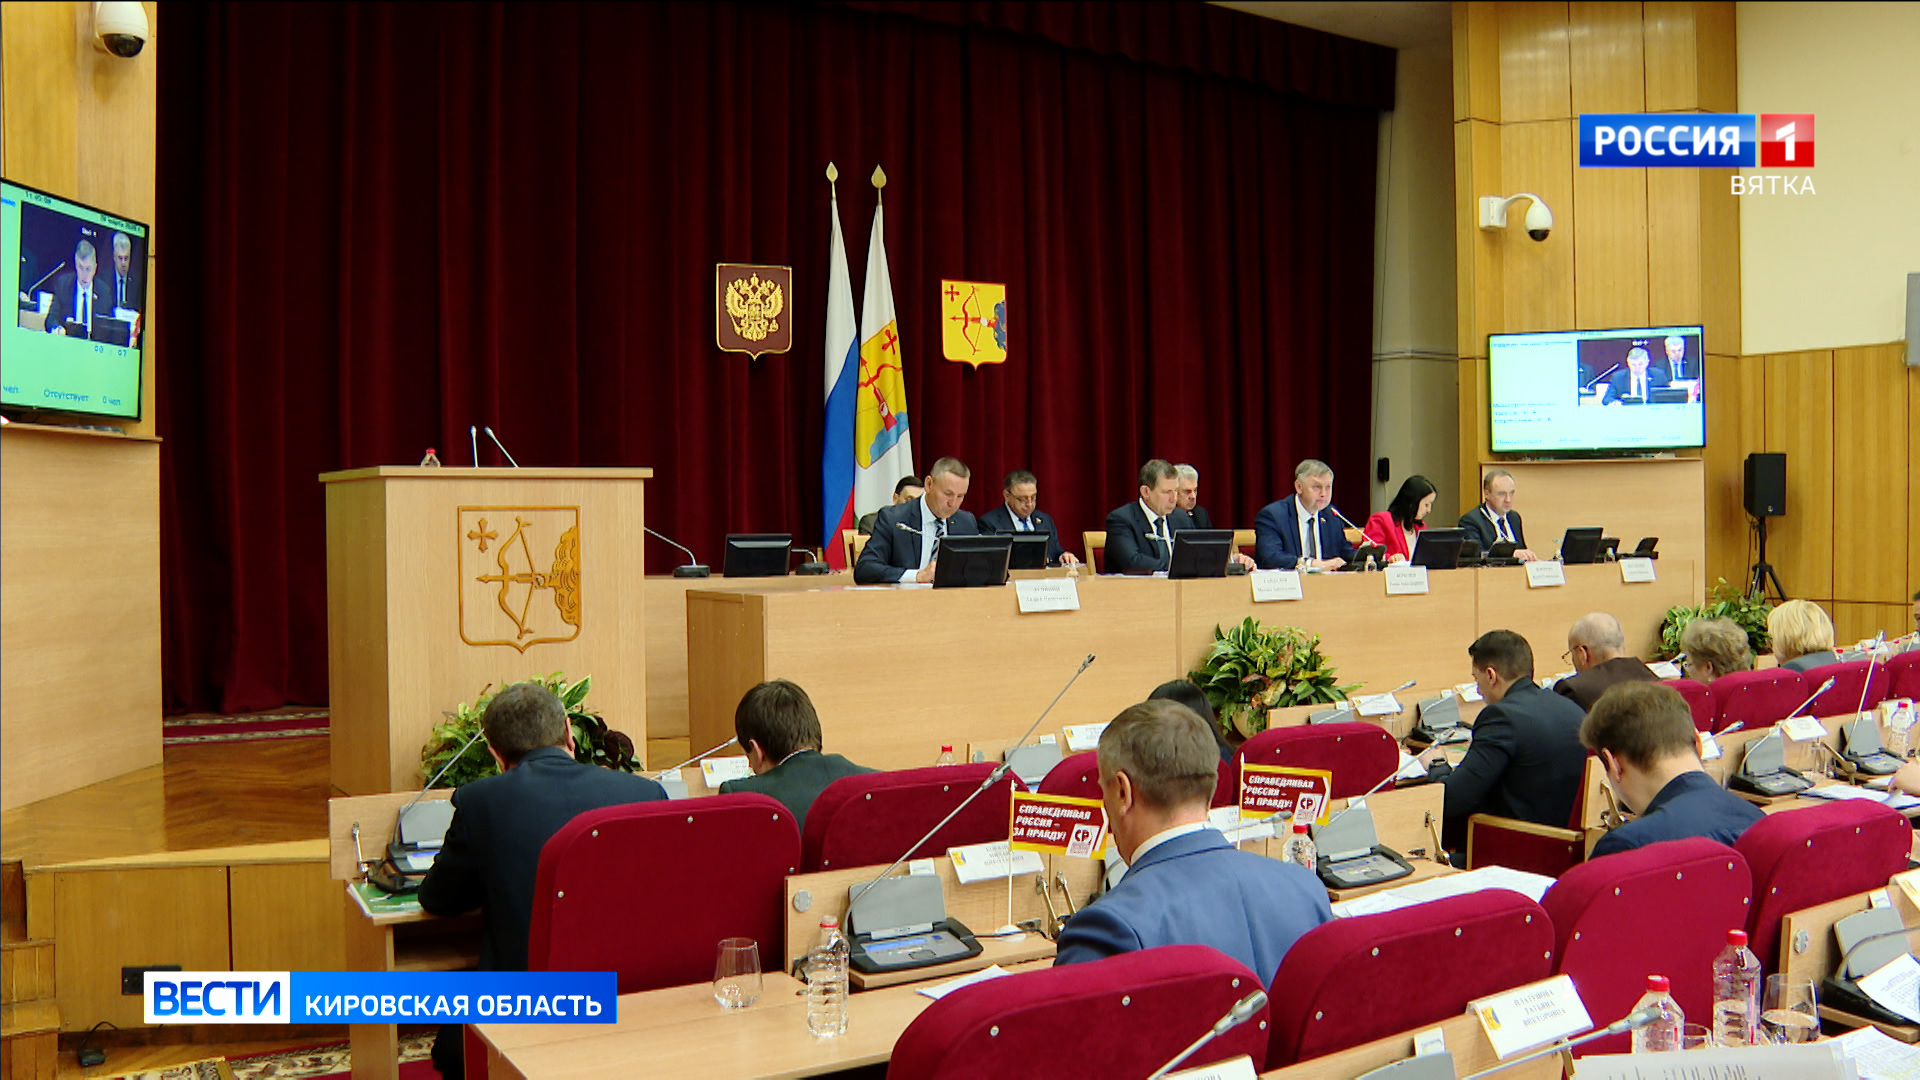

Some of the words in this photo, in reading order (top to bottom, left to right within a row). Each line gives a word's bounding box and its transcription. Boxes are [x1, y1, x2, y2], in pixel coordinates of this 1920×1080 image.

[43, 388, 89, 403] Отсутствует
[1248, 775, 1315, 790] СПРАВЕДЛИВАЯ
[1245, 785, 1281, 796] РОССИЯ
[1243, 797, 1256, 806] ЗА
[1256, 797, 1293, 810] ПРАВДУ!
[1018, 803, 1092, 820] СПРАВЕДЛИВАЯ
[1015, 815, 1053, 828] РОССИЯ
[1013, 827, 1025, 837] ЗА
[1026, 828, 1067, 842] ПРАВДУ!
[1523, 1000, 1555, 1015] ТАТЬЯНА
[1522, 1007, 1566, 1027] ВИКТОРОВНА
